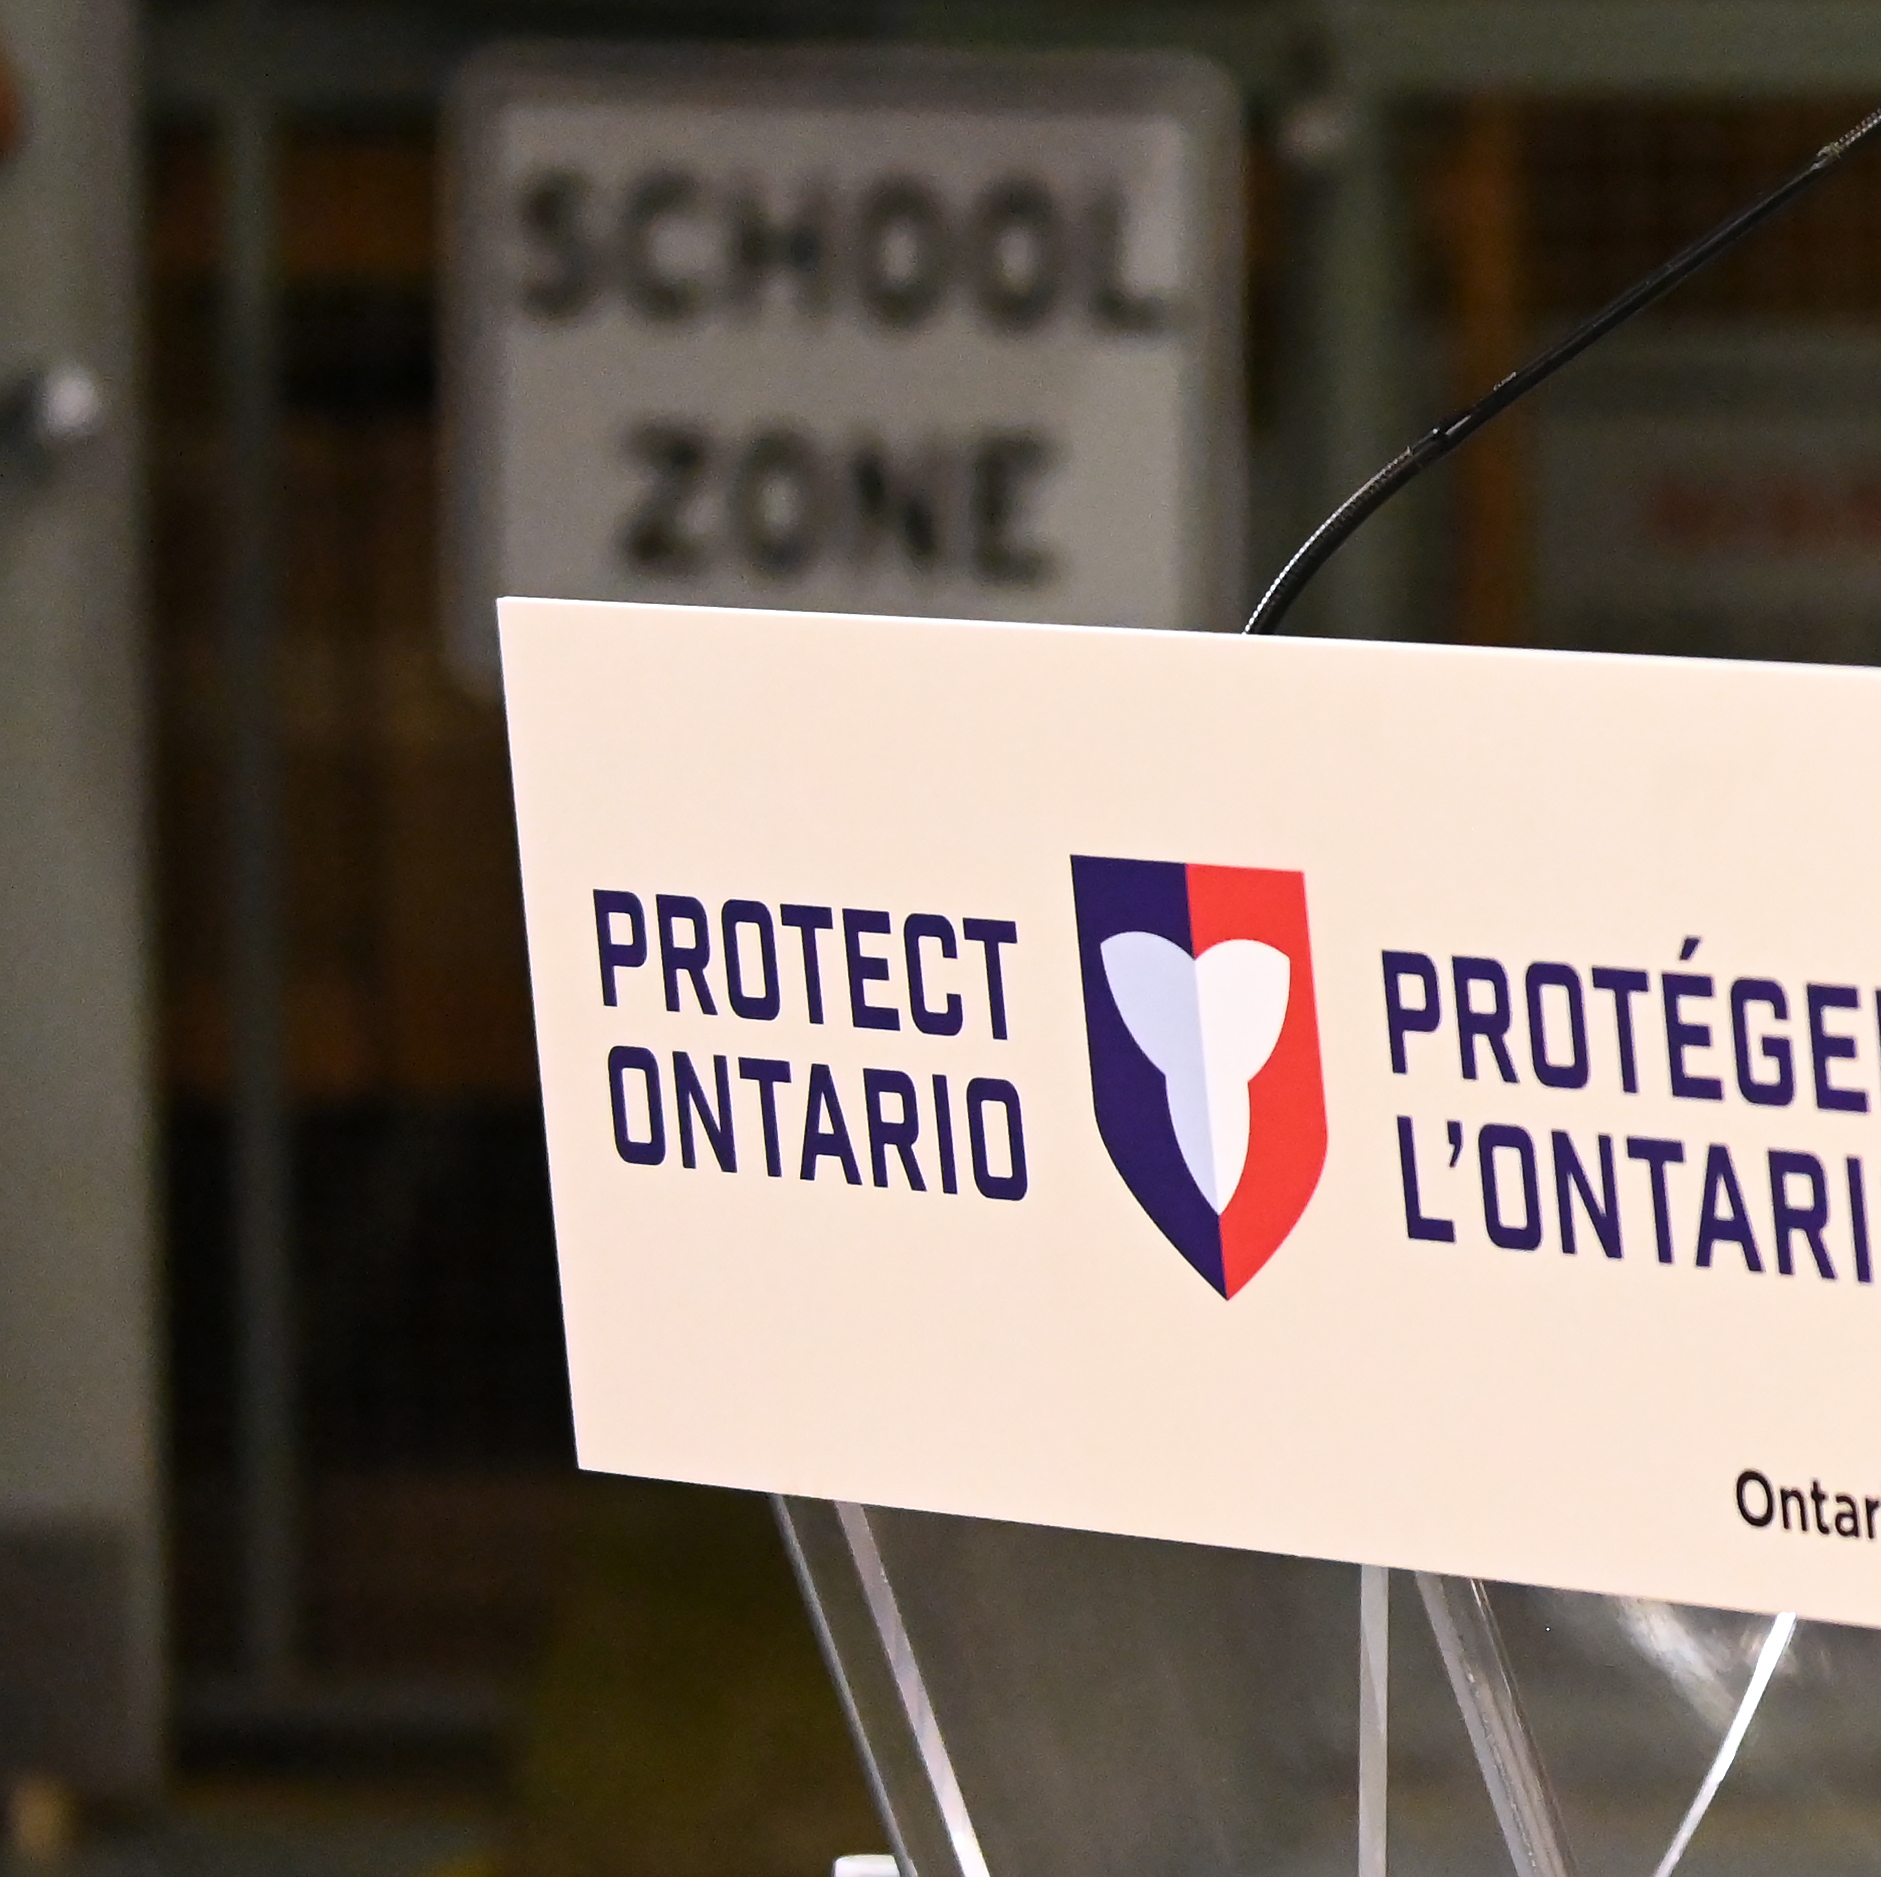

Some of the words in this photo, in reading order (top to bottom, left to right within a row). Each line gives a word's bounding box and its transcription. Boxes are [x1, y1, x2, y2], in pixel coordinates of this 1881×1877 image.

[514, 165, 1180, 337] SCHOOL
[618, 423, 1060, 587] ZONE
[593, 889, 1017, 1040] PROTECT
[608, 1046, 1027, 1201] ONTARIO
